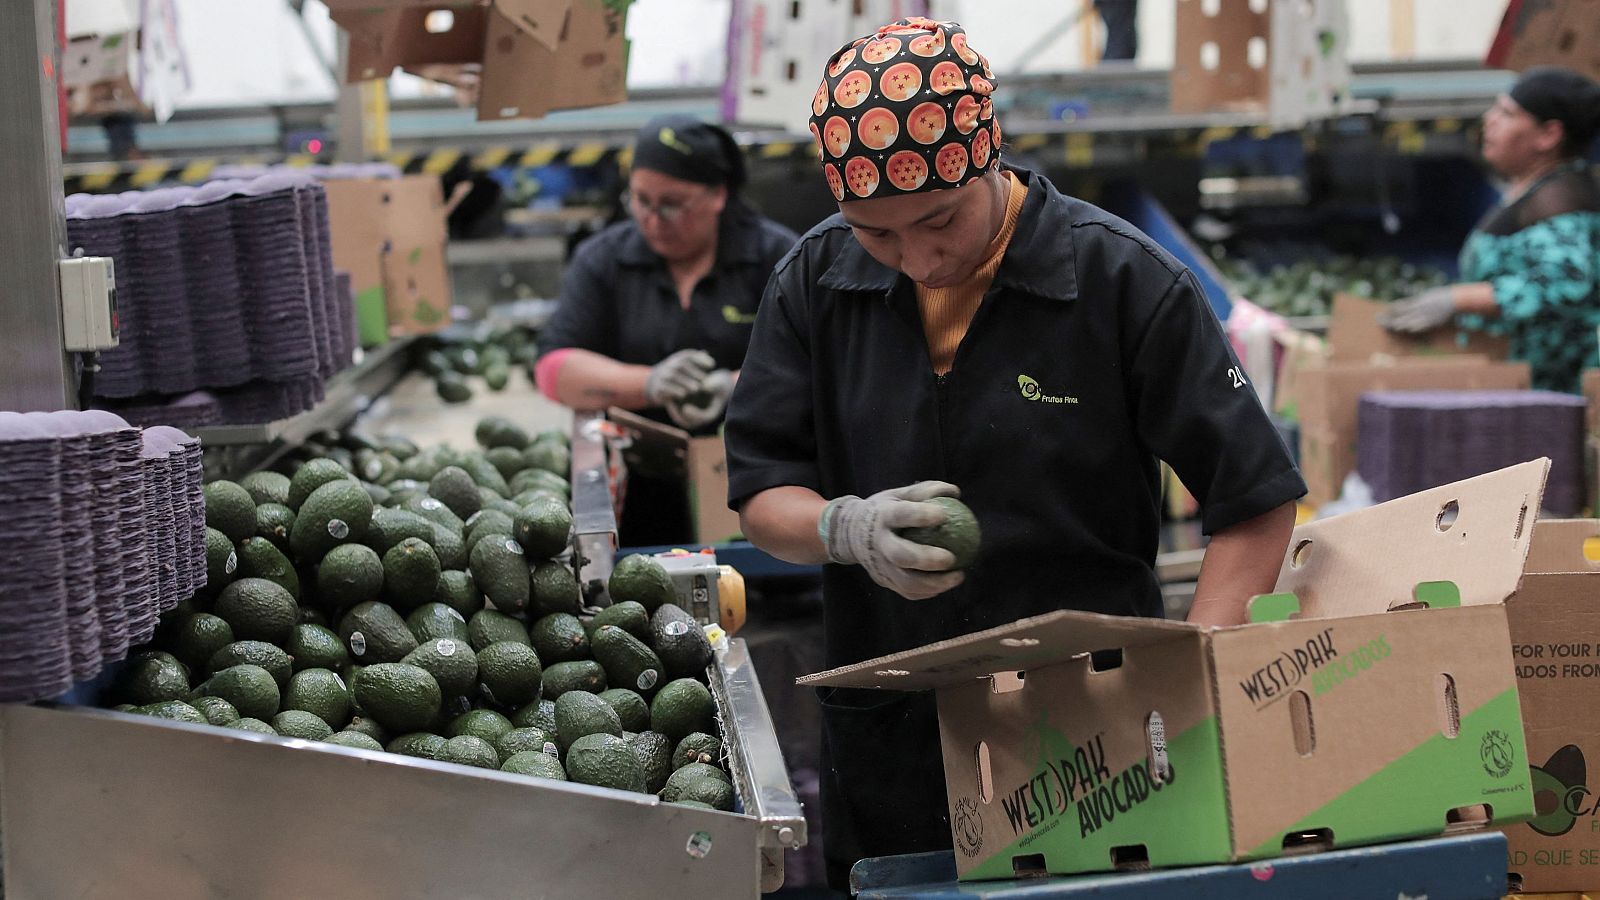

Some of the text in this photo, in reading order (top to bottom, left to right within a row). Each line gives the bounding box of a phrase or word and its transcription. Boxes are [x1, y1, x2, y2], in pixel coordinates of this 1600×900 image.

[1239, 630, 1337, 706] WEST PAK
[1311, 632, 1392, 696] AVOCADOS
[1512, 644, 1544, 658] FOR
[1549, 644, 1590, 657] YOUR
[1001, 770, 1054, 837] WEST
[1060, 734, 1111, 803] PAK
[1533, 848, 1573, 866] QUE
